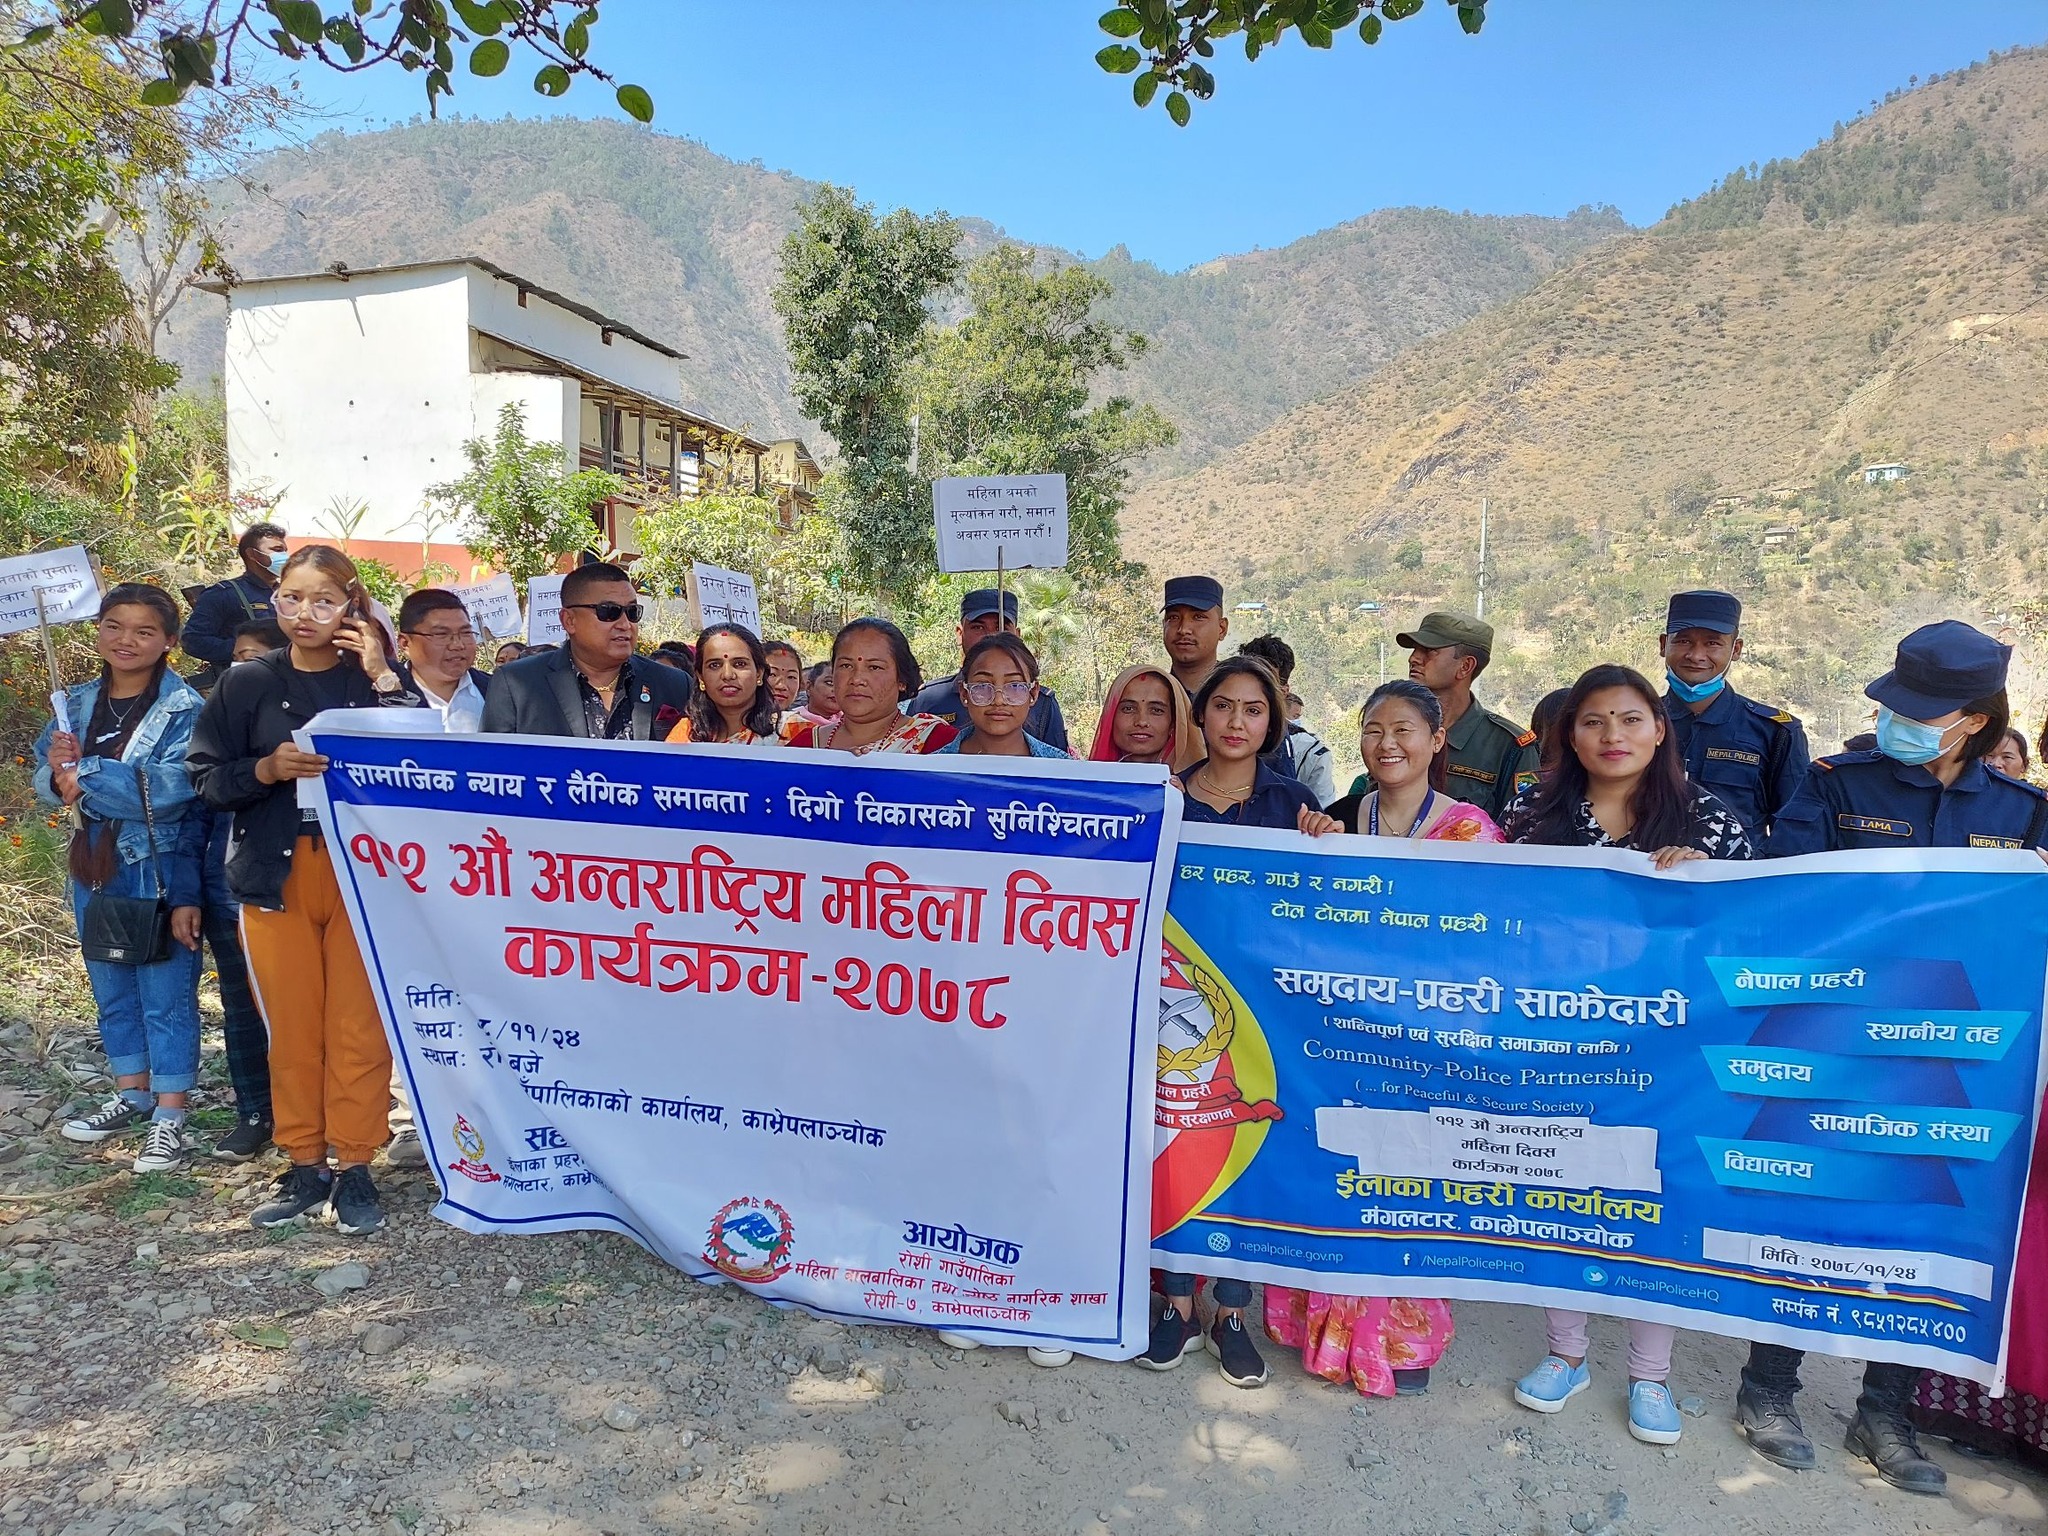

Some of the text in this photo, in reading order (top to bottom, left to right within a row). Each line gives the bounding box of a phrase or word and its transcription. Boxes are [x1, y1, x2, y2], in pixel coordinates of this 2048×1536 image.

[967, 485, 1002, 502] महिला
[1026, 506, 1056, 519] समान
[956, 529, 989, 541] अवसर
[993, 528, 1021, 540] प्रदान
[1708, 750, 1758, 763] NEPAL POLICE
[467, 771, 526, 801] न्याय
[537, 777, 556, 804] र
[567, 769, 641, 806] लैंगिक
[653, 785, 748, 815] समानता
[787, 786, 844, 822] दिगो
[854, 791, 975, 830] विकासको
[1861, 819, 1892, 832] LAMA
[1972, 837, 2003, 849] NEPAL
[1180, 864, 1205, 881] हर
[1213, 867, 1256, 886] प्रहर,
[1265, 872, 1300, 888] गाउँ
[1308, 876, 1323, 891] र
[448, 826, 512, 898] औ
[528, 844, 806, 936] अन्तराष्ट्रिय
[821, 861, 987, 943] महिला
[1003, 869, 1140, 958] दिवस
[1271, 898, 1306, 919] टोल
[1314, 903, 1371, 924] टोलमा
[1379, 907, 1430, 929] नेपाल
[1439, 912, 1488, 933] प्रहरी
[504, 921, 1010, 1030] कार्यक्रम-२०७८
[1734, 967, 1866, 991] नेपाल प्रहरी
[1273, 967, 1689, 1028] समुदाय-प्रहरी साझेदारी
[1434, 1028, 1494, 1049] सुरक्षित
[1498, 1035, 1572, 1054] समाजका
[1577, 1040, 1620, 1055] लागि
[1865, 1021, 2002, 1045] स्थानीय तह
[508, 1050, 544, 1074] बजे
[1303, 1039, 1653, 1092] Community-Police Partnership
[1727, 1057, 1813, 1083] समुदाय
[1181, 1083, 1212, 1100] प्रहरी
[1381, 1081, 1401, 1094] for
[1404, 1084, 1460, 1102] Peaceful
[1465, 1094, 1478, 1105] &
[1482, 1095, 1528, 1111] Secure
[1532, 1100, 1584, 1114] Society
[641, 1096, 728, 1132] कार्यालय,
[742, 1108, 887, 1147] काभ्रेपलाञ्चोक
[1436, 1115, 1584, 1141] ११२ औ अन्तराष्ट्रिय
[1808, 1113, 1991, 1144] सामाजिक संस्था
[1461, 1138, 1557, 1159] महिला दिवस
[1452, 1158, 1564, 1179] कार्यक्रम २०७८
[1723, 1150, 1814, 1179] विद्यालय
[1335, 1169, 1664, 1224] ईलाका प्रहरी कार्यालय
[902, 1220, 1023, 1265] आयोजक
[1470, 1214, 1635, 1249] काभ्रेपलाञ्चोक
[899, 1250, 1015, 1286] रोशी गाउँपालिका
[1239, 1241, 1343, 1264] nepalpolice.gov.np
[1421, 1255, 1525, 1274] /NepalPolicePHQ
[1615, 1275, 1721, 1303] /NepalPoliceHQ
[1810, 1257, 1918, 1280] २०७८/११/२४
[795, 1259, 839, 1281] महिला
[932, 1280, 959, 1295] तथा
[1006, 1288, 1063, 1307] नागरिक
[1070, 1293, 1108, 1305] शाखा
[932, 1299, 1033, 1322] काभ्रेपलाञ्चोक
